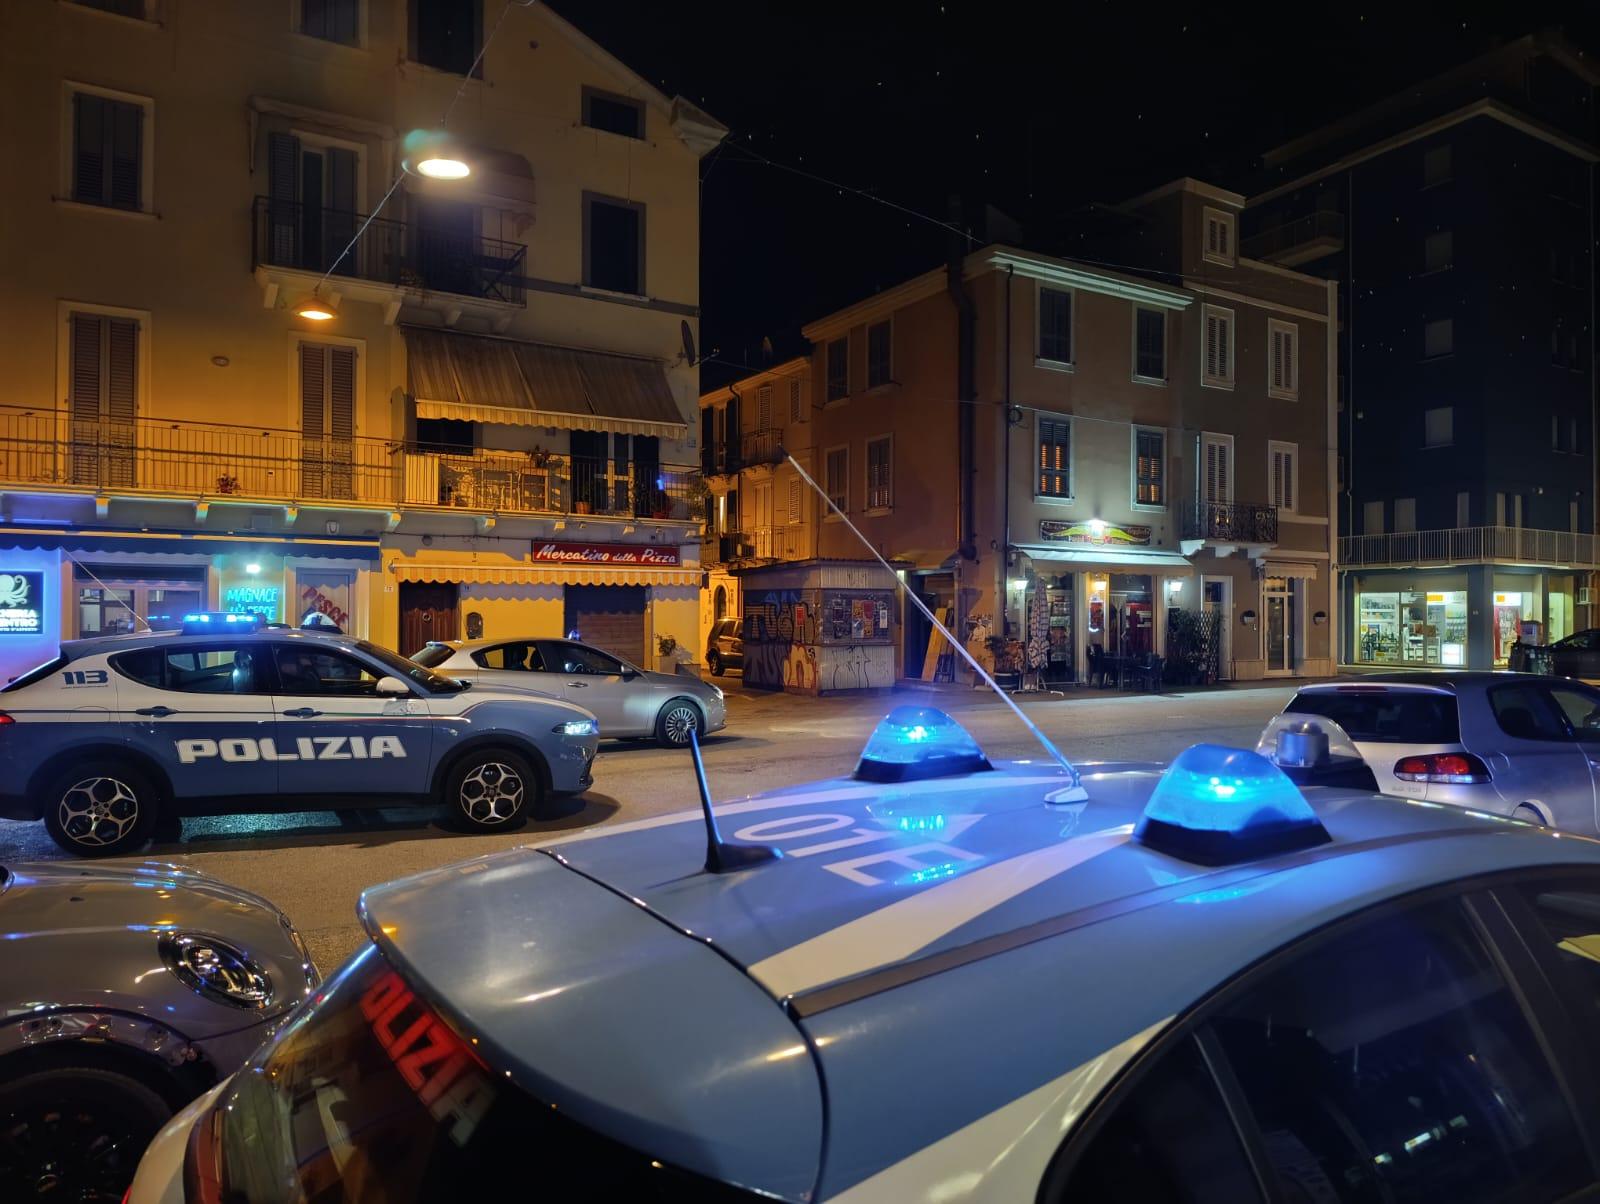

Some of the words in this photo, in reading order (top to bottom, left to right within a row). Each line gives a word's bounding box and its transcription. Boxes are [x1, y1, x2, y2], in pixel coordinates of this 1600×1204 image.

[536, 545, 609, 561] Mercatino
[640, 548, 676, 563] Pizza
[227, 587, 278, 603] MAGNACE
[62, 670, 109, 685] 113
[175, 736, 408, 764] POLIZIA
[358, 968, 497, 1147] OLIZIA
